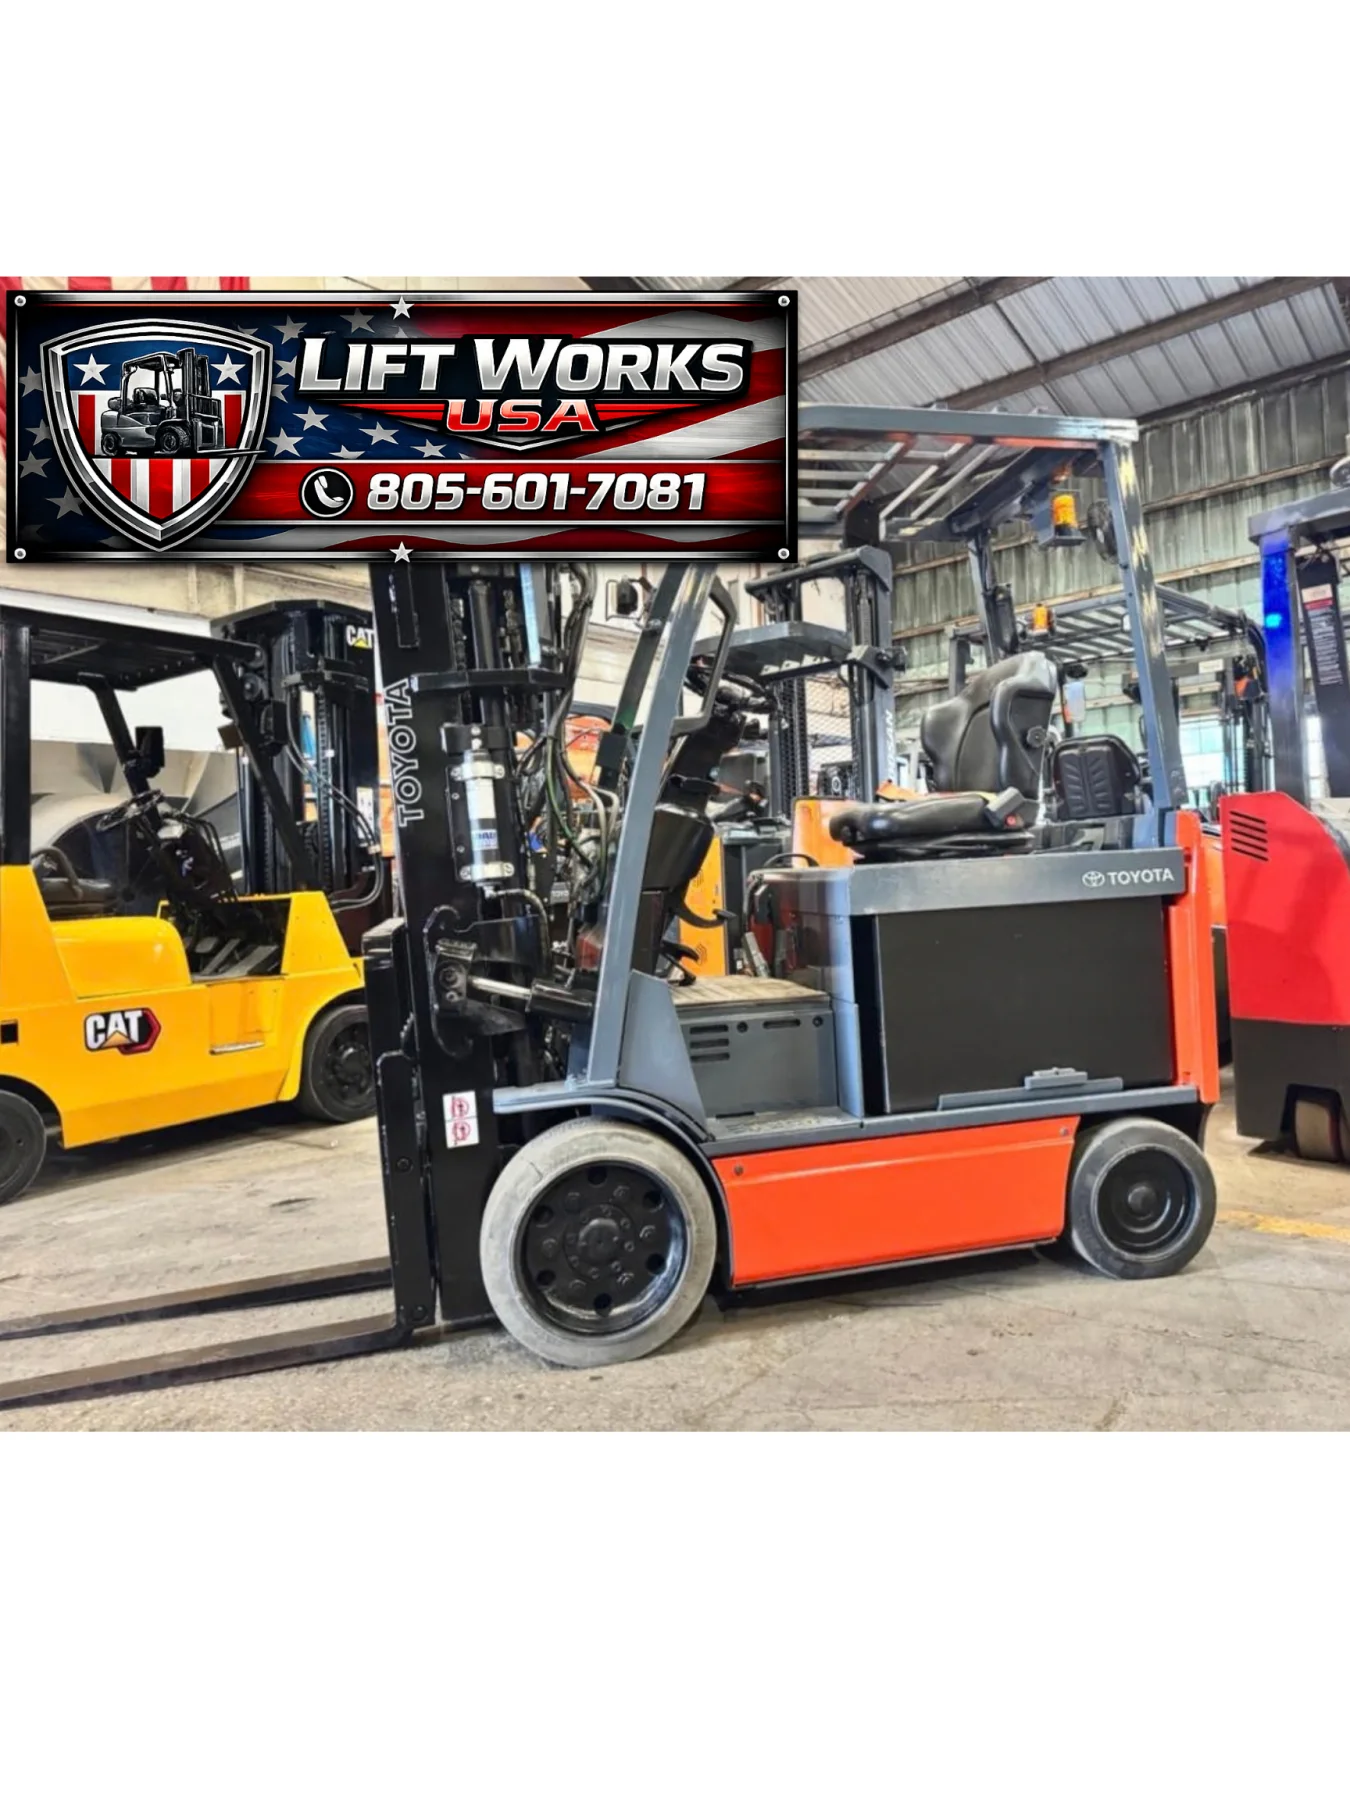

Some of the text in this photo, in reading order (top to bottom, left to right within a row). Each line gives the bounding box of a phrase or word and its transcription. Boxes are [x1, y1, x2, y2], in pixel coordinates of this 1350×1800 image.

[345, 624, 374, 649] CAT
[384, 677, 425, 828] TOYOTA
[1106, 867, 1175, 886] TOYOTA
[85, 1009, 143, 1050] CAT
